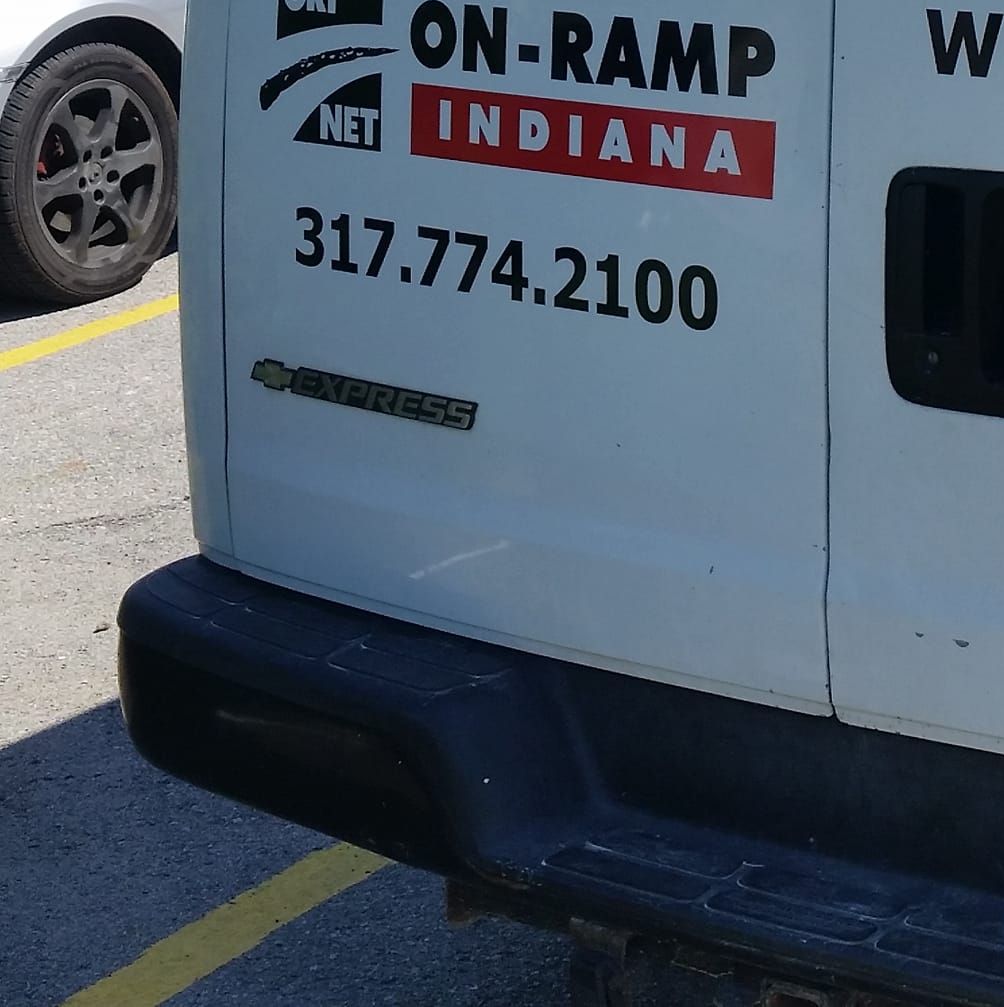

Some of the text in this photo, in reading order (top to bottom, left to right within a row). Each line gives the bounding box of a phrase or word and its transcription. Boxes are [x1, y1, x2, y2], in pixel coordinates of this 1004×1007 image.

[410, 0, 776, 98] ON-RAMP
[319, 104, 379, 147] NET
[438, 99, 741, 176] INDIANA
[295, 206, 718, 331] 317.774.2100
[292, 367, 477, 429] EXPRESS
